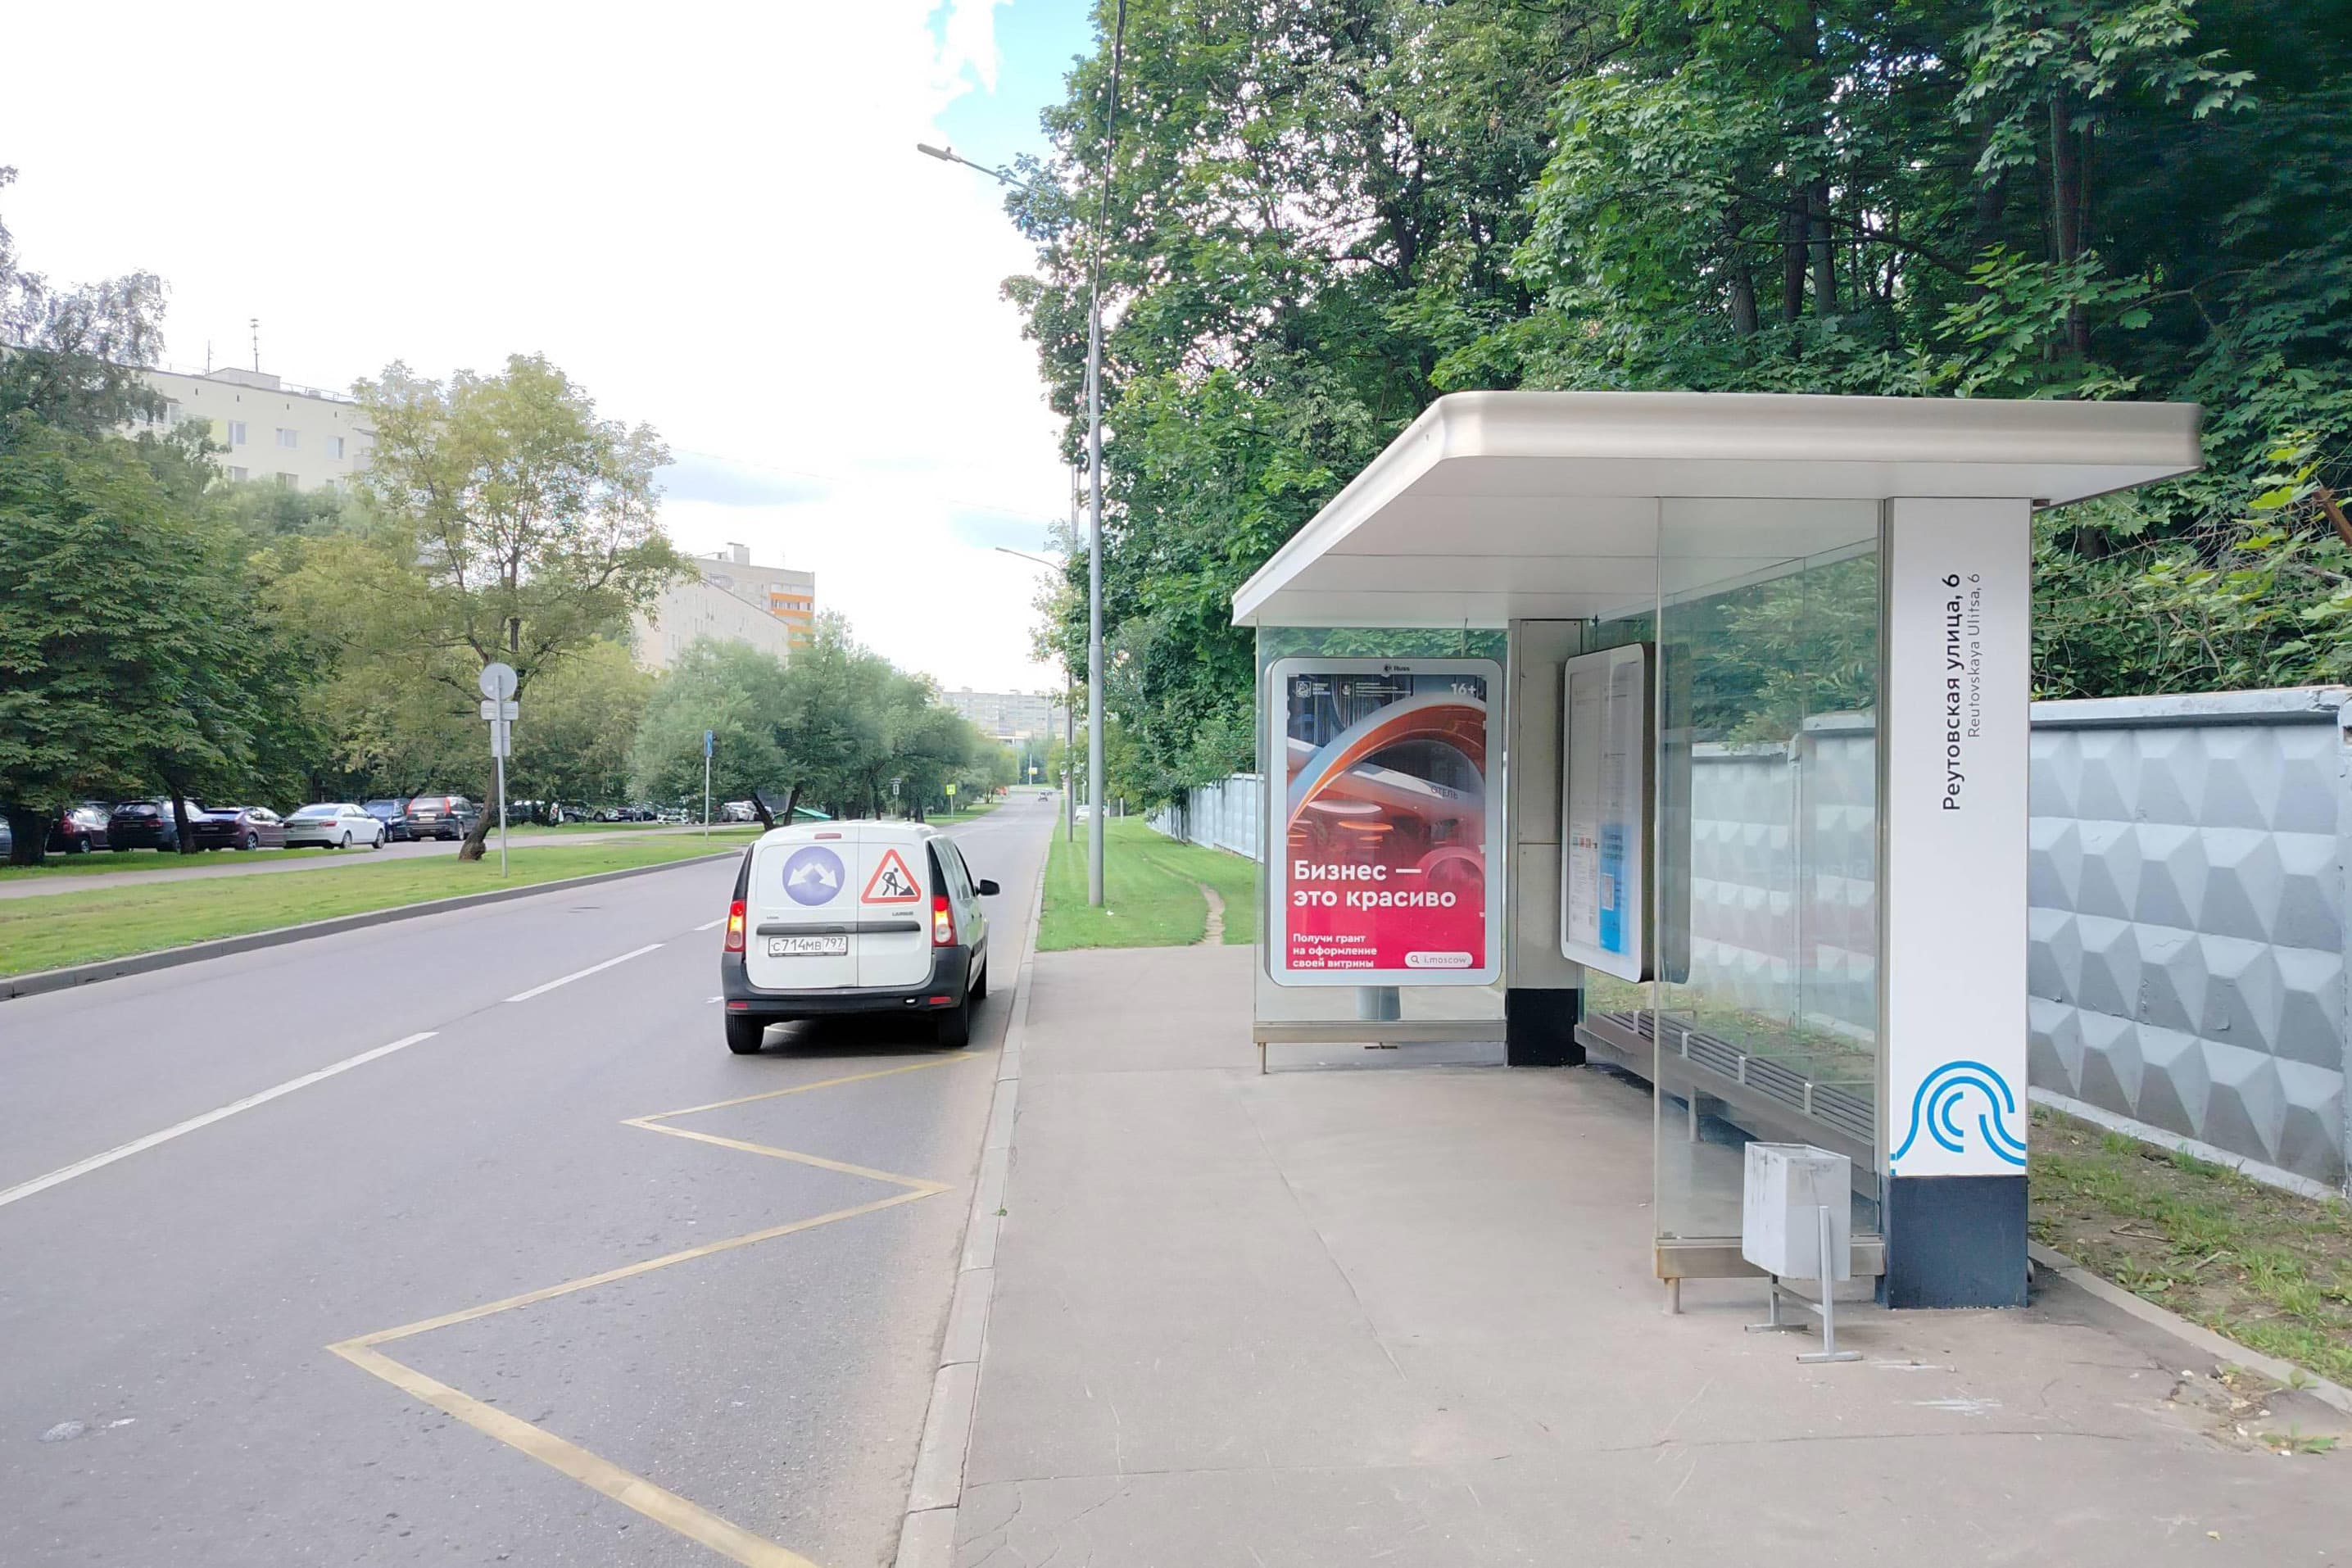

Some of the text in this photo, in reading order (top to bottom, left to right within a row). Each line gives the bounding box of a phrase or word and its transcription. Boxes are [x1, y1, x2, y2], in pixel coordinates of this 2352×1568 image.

[1967, 573, 1983, 737] Reutovskaya Ulitsa, 6
[1450, 682, 1476, 696] 16+
[1942, 573, 1965, 810] Реутовская улица, 6
[1294, 859, 1387, 881] Бизнес
[1294, 890, 1457, 912] это красиво
[1293, 933, 1366, 945] Получи грант
[1293, 945, 1377, 957] на оформление
[1293, 957, 1375, 969] своей витрины
[1424, 954, 1467, 964] i.moscow
